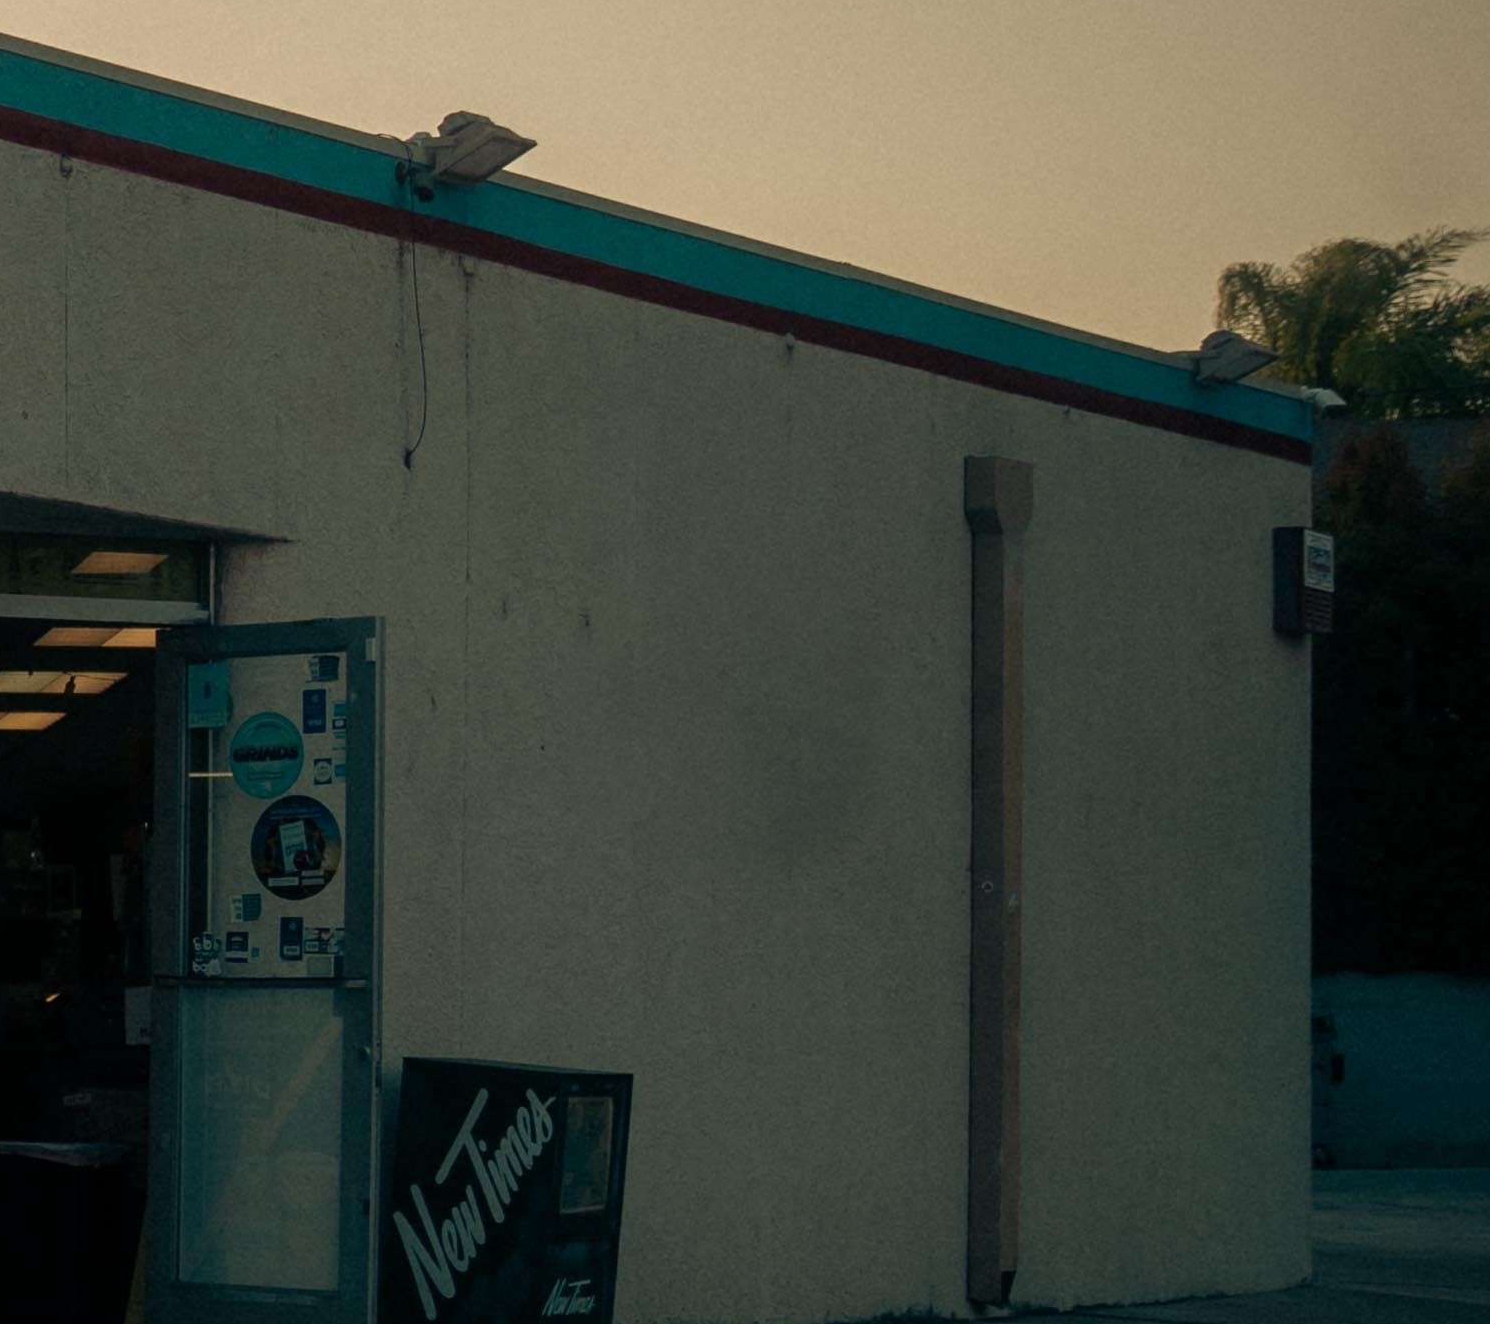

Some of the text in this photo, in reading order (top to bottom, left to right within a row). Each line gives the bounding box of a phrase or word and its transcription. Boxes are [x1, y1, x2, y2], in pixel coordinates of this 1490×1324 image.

[233, 745, 299, 763] GRINDS
[393, 1088, 557, 1320] New Times
